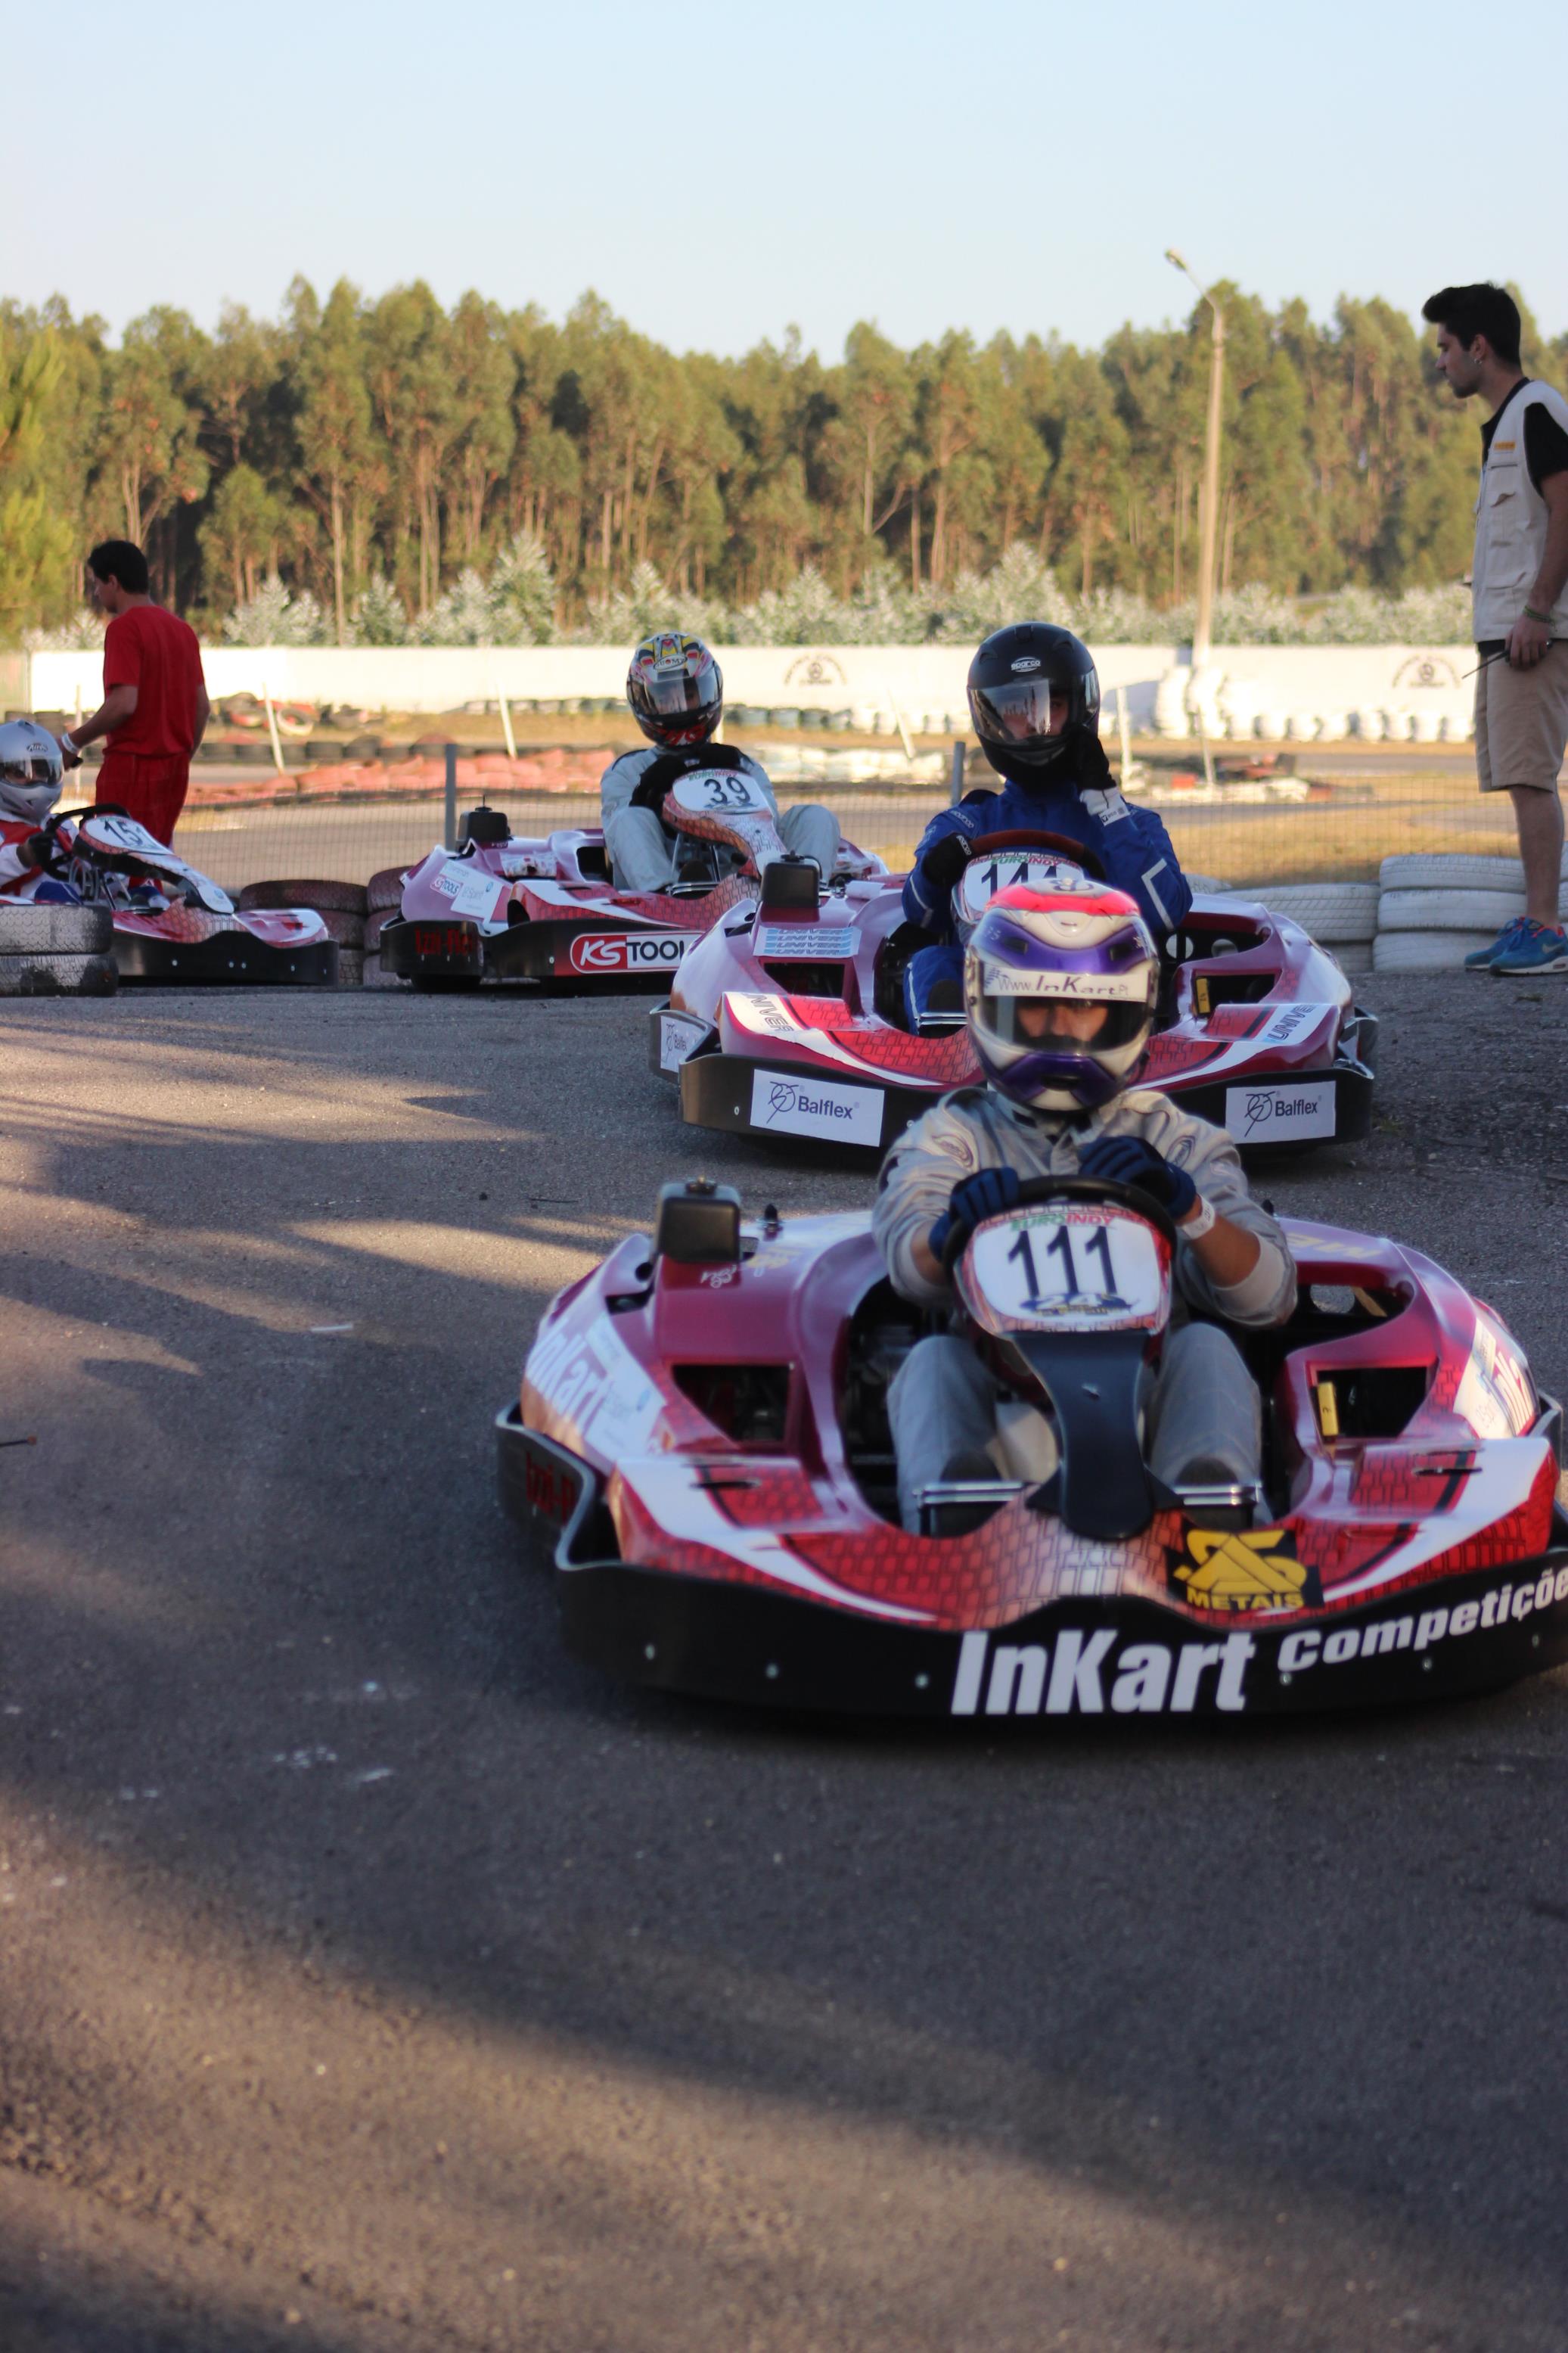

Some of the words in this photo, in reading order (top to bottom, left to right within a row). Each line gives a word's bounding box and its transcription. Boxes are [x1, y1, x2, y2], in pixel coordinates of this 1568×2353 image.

[703, 777, 750, 804] 39
[104, 820, 157, 847] 151
[580, 940, 626, 966] KS
[798, 1096, 853, 1120] Balflex
[1275, 1099, 1318, 1117] Balflex
[1008, 1226, 1117, 1297] 111
[1187, 1584, 1305, 1610] METAIS
[951, 1630, 1256, 1714] InKart
